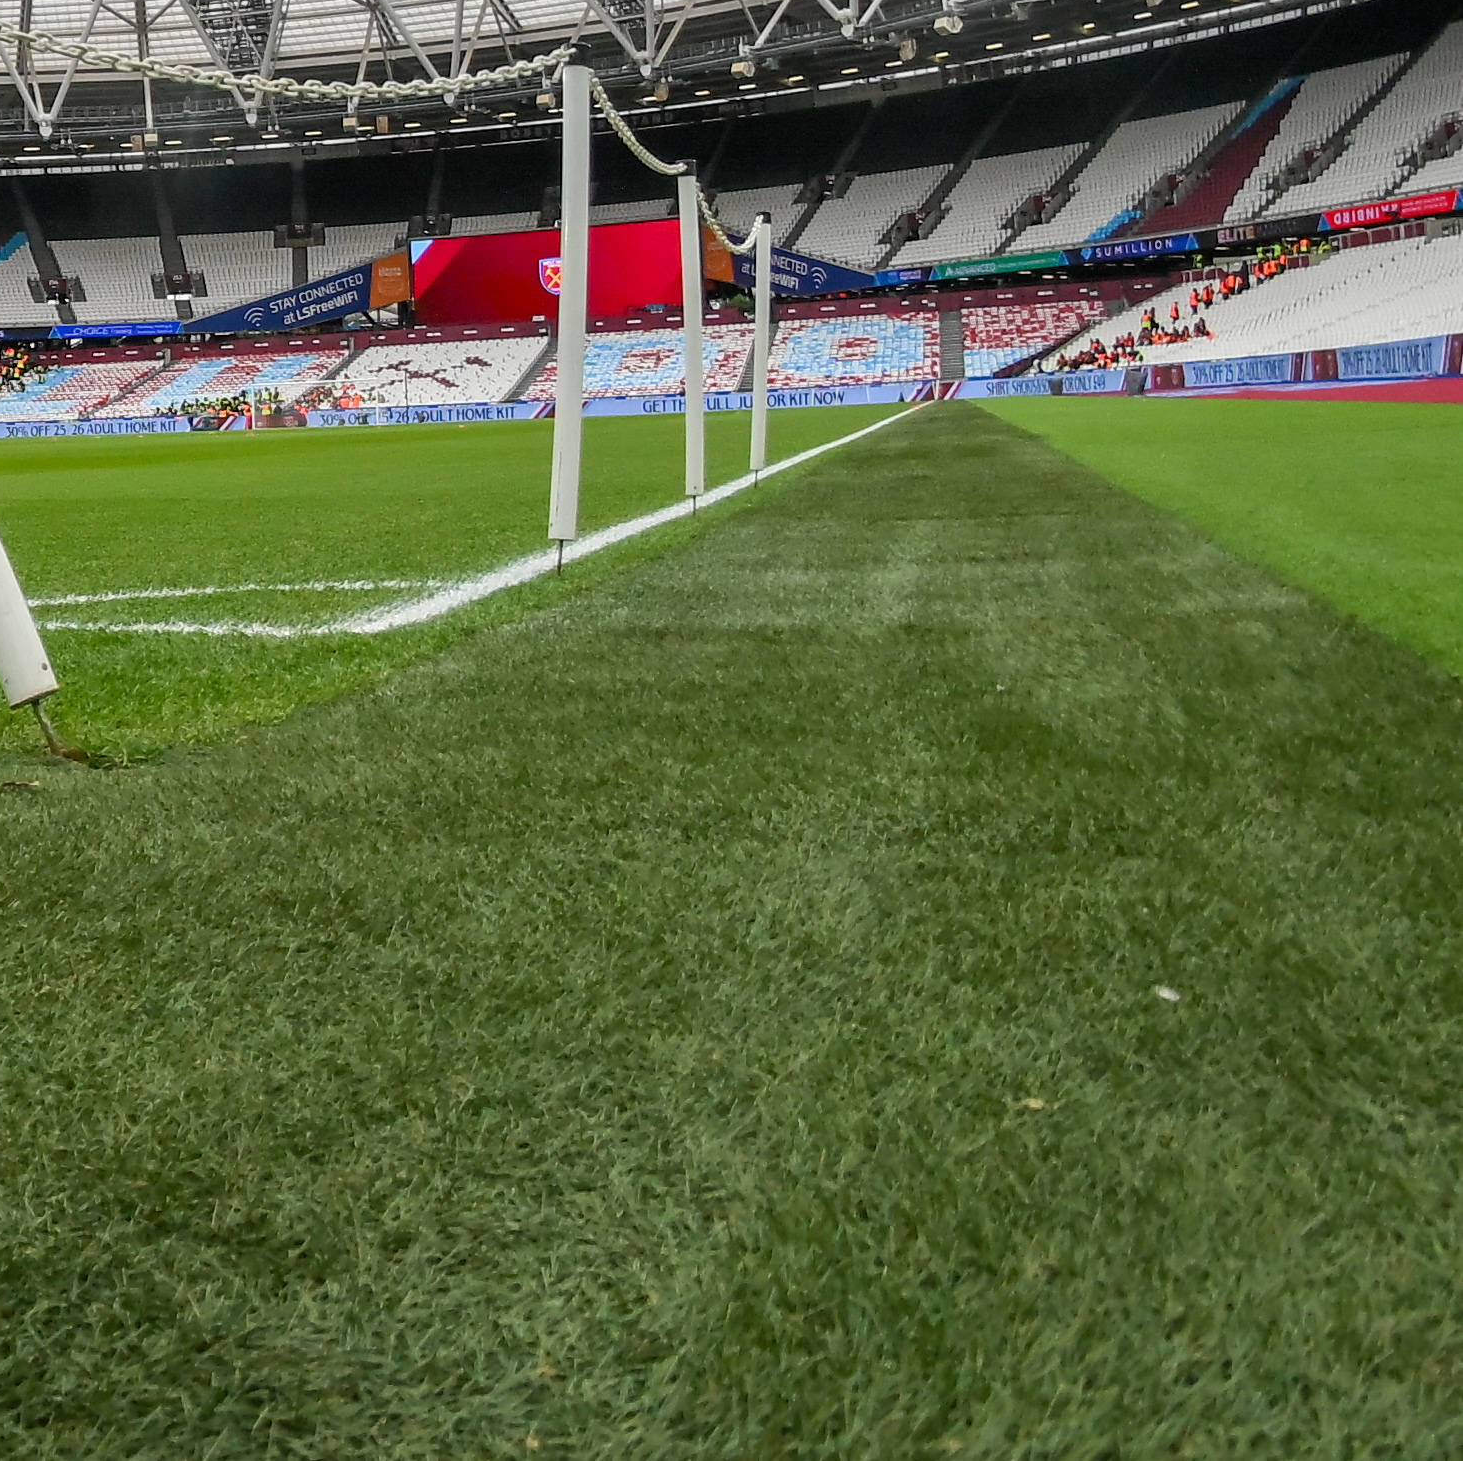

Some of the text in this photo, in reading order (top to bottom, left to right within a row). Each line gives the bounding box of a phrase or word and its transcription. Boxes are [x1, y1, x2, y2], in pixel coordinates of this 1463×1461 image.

[1095, 239, 1173, 258] SUMILLION
[269, 273, 363, 314] STAY CONNECTED
[283, 313, 296, 325] at
[642, 399, 666, 413] GET
[670, 398, 686, 411] TH
[738, 393, 786, 410] JUOR
[790, 392, 809, 406] KIT
[813, 391, 845, 406] NOW
[455, 407, 493, 421] HOME
[496, 406, 515, 419] KIT
[6, 425, 28, 438] 30%
[30, 425, 50, 437] OFF
[86, 422, 125, 435] ADULT
[125, 421, 157, 434] HOME
[161, 420, 176, 432] KIT
